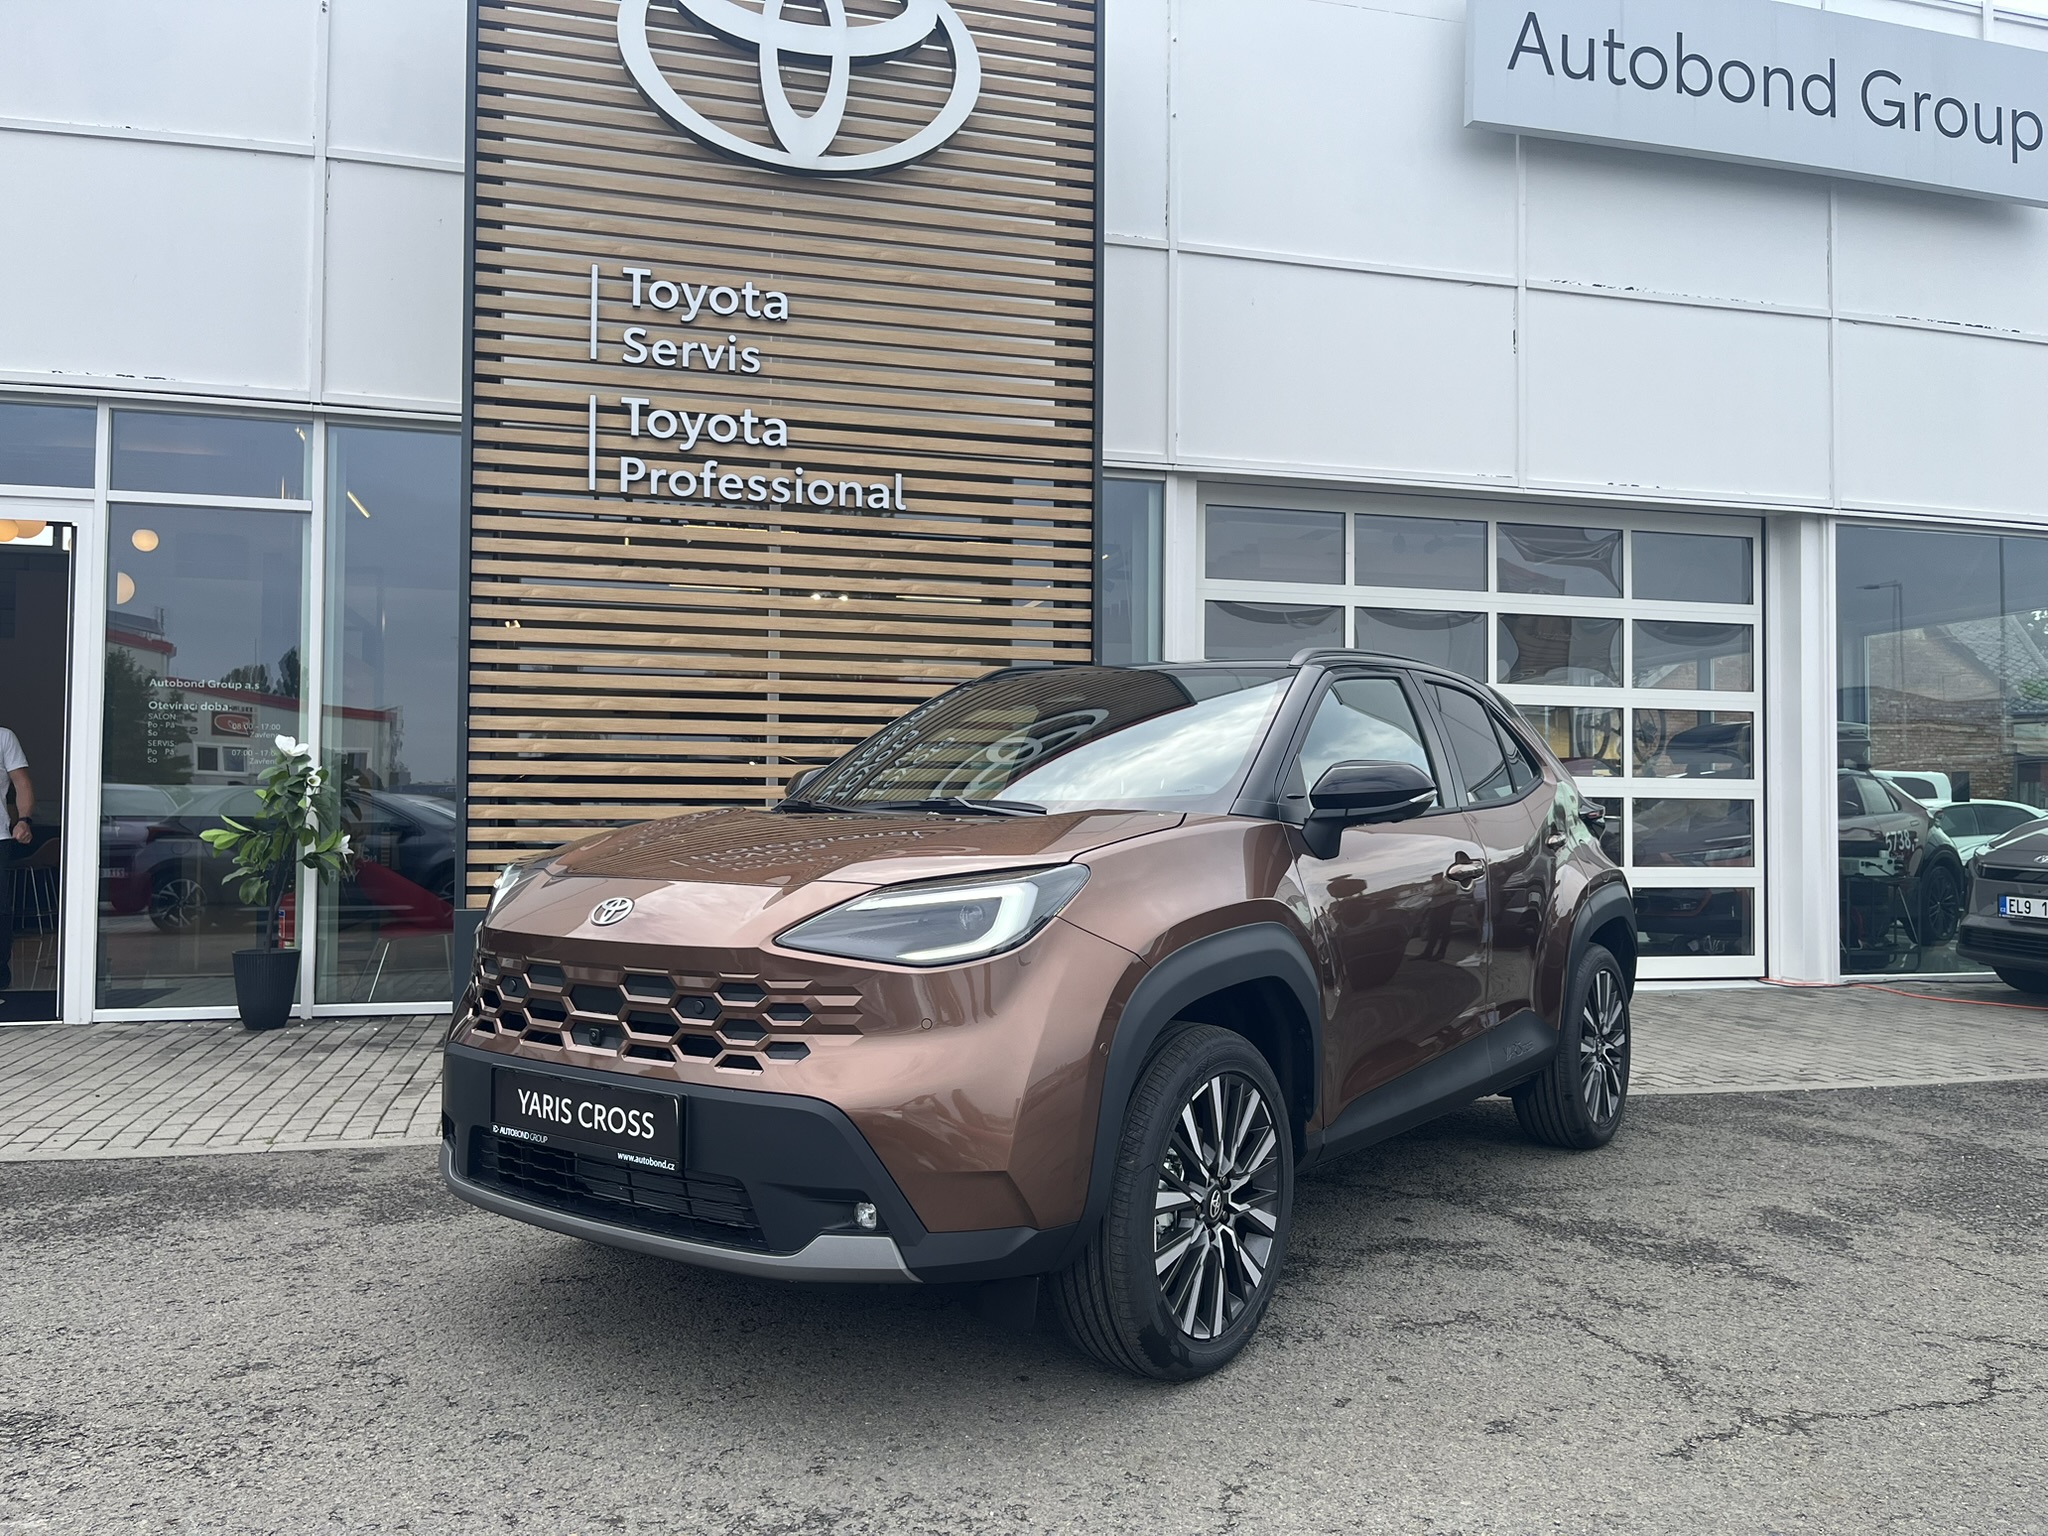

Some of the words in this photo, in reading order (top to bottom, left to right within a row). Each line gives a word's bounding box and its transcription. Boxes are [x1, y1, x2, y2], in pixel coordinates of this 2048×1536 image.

[1507, 11, 1837, 118] Autobond
[1861, 69, 2044, 164] Group
[622, 267, 789, 322] Toyota
[622, 327, 761, 374] Servis
[621, 397, 788, 451] Toyota
[620, 457, 907, 511] Professional
[149, 678, 205, 688] Autobond
[207, 680, 242, 690] Group
[147, 729, 158, 737] So
[147, 747, 158, 755] Po
[147, 756, 158, 764] So
[2009, 898, 2032, 914] EL9
[517, 1088, 573, 1125] YARIS
[577, 1101, 655, 1139] CROSS
[499, 1126, 530, 1139] AUTOBOND
[530, 1132, 548, 1143] GROUP
[617, 1152, 675, 1171] www.autobond.cz
